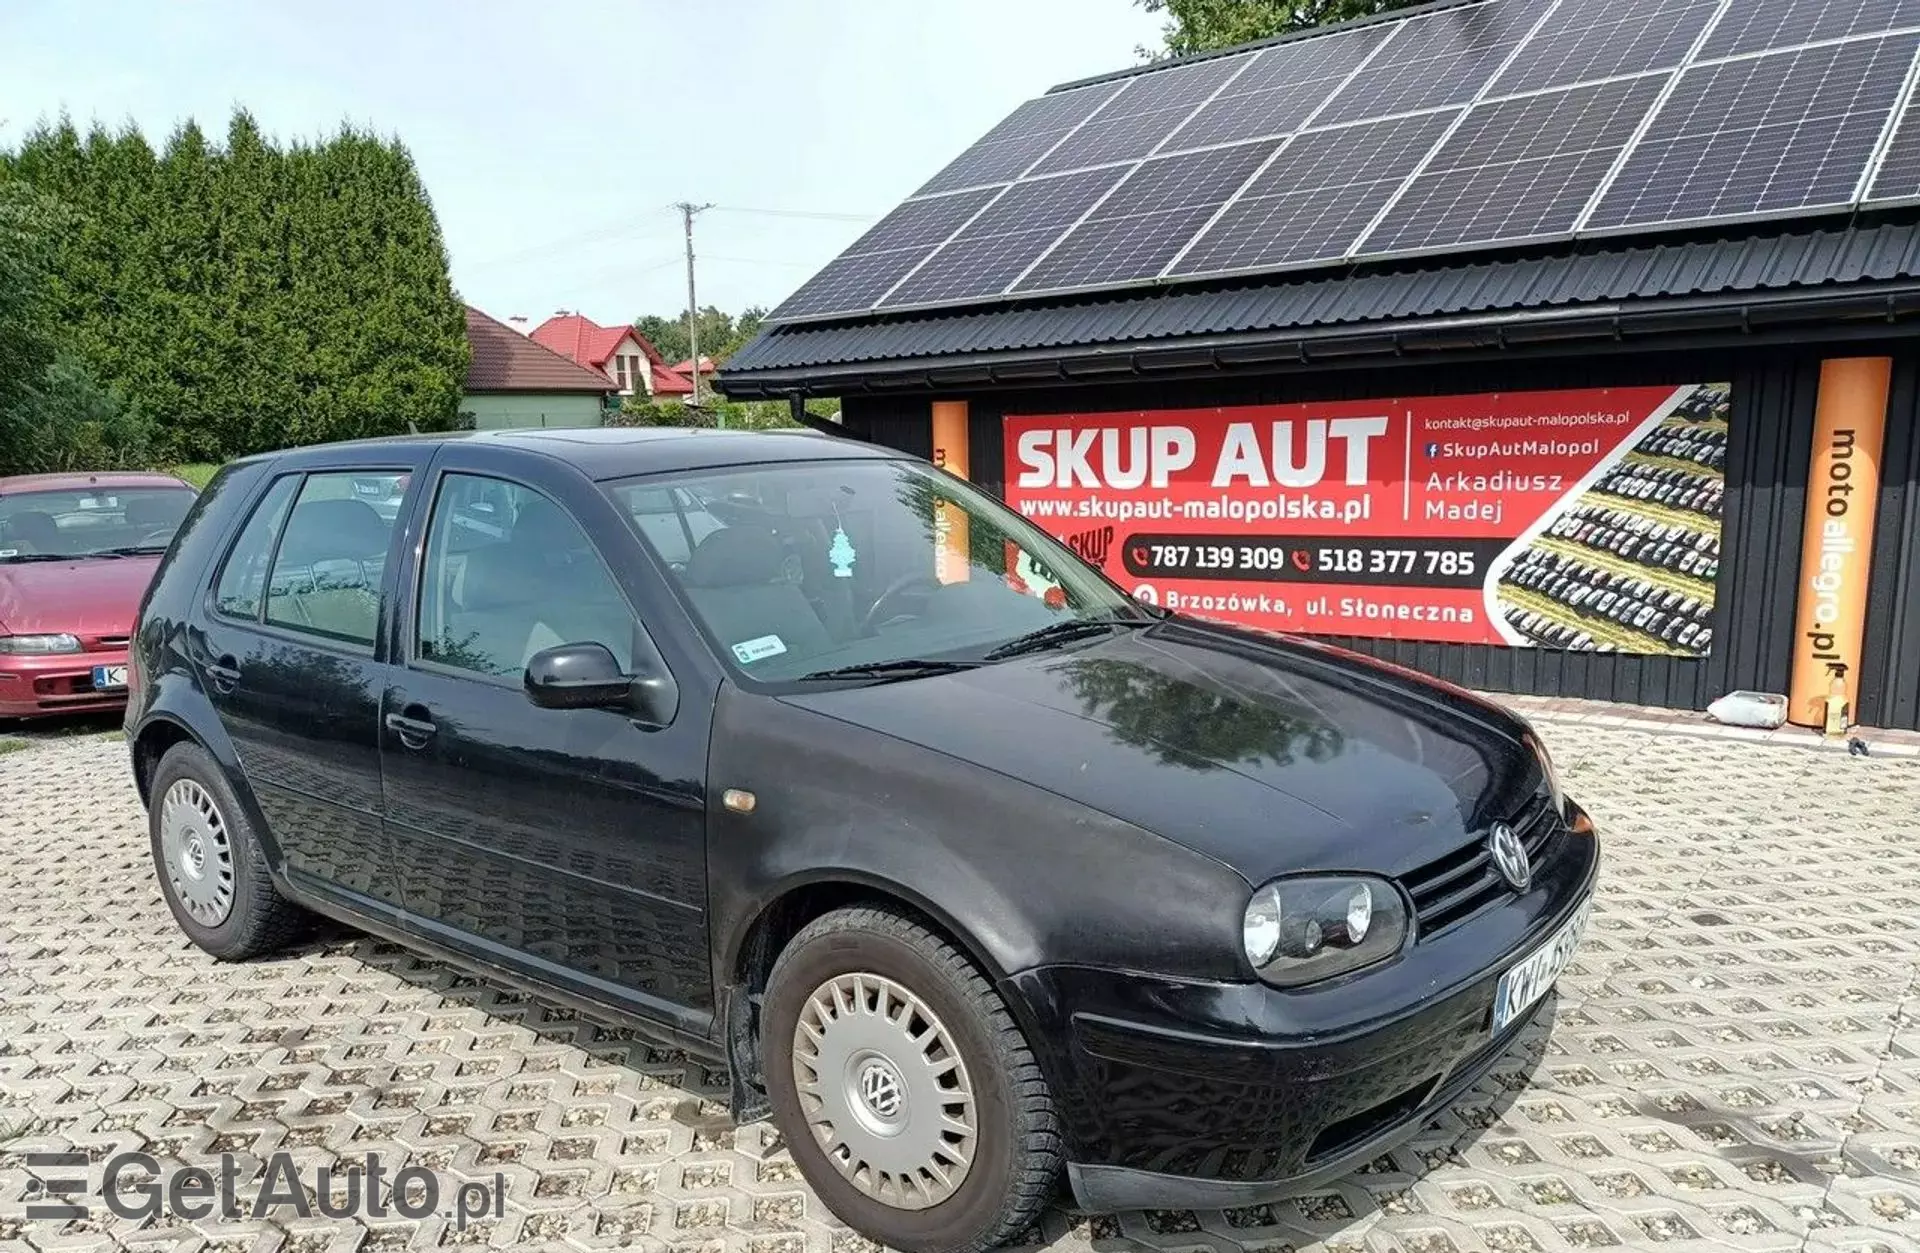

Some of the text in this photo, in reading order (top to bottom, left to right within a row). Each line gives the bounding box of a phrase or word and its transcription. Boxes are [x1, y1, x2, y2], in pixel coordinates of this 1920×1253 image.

[1425, 411, 1630, 431] kontakt@skupaut-malopolska.pl
[1017, 416, 1389, 490] SKUP AUT
[1443, 439, 1598, 459] SkupAutMalopol
[1426, 470, 1562, 491] Arkadiusz
[1019, 494, 1371, 523] www.skupaut-malopolska.pl
[1426, 500, 1502, 524] Madej
[1069, 526, 1113, 560] SKUP
[1151, 546, 1284, 570] 787 139 309
[1318, 549, 1475, 575] 518 377 785
[1166, 590, 1474, 623] Brzozówka, ul. Słoneczna
